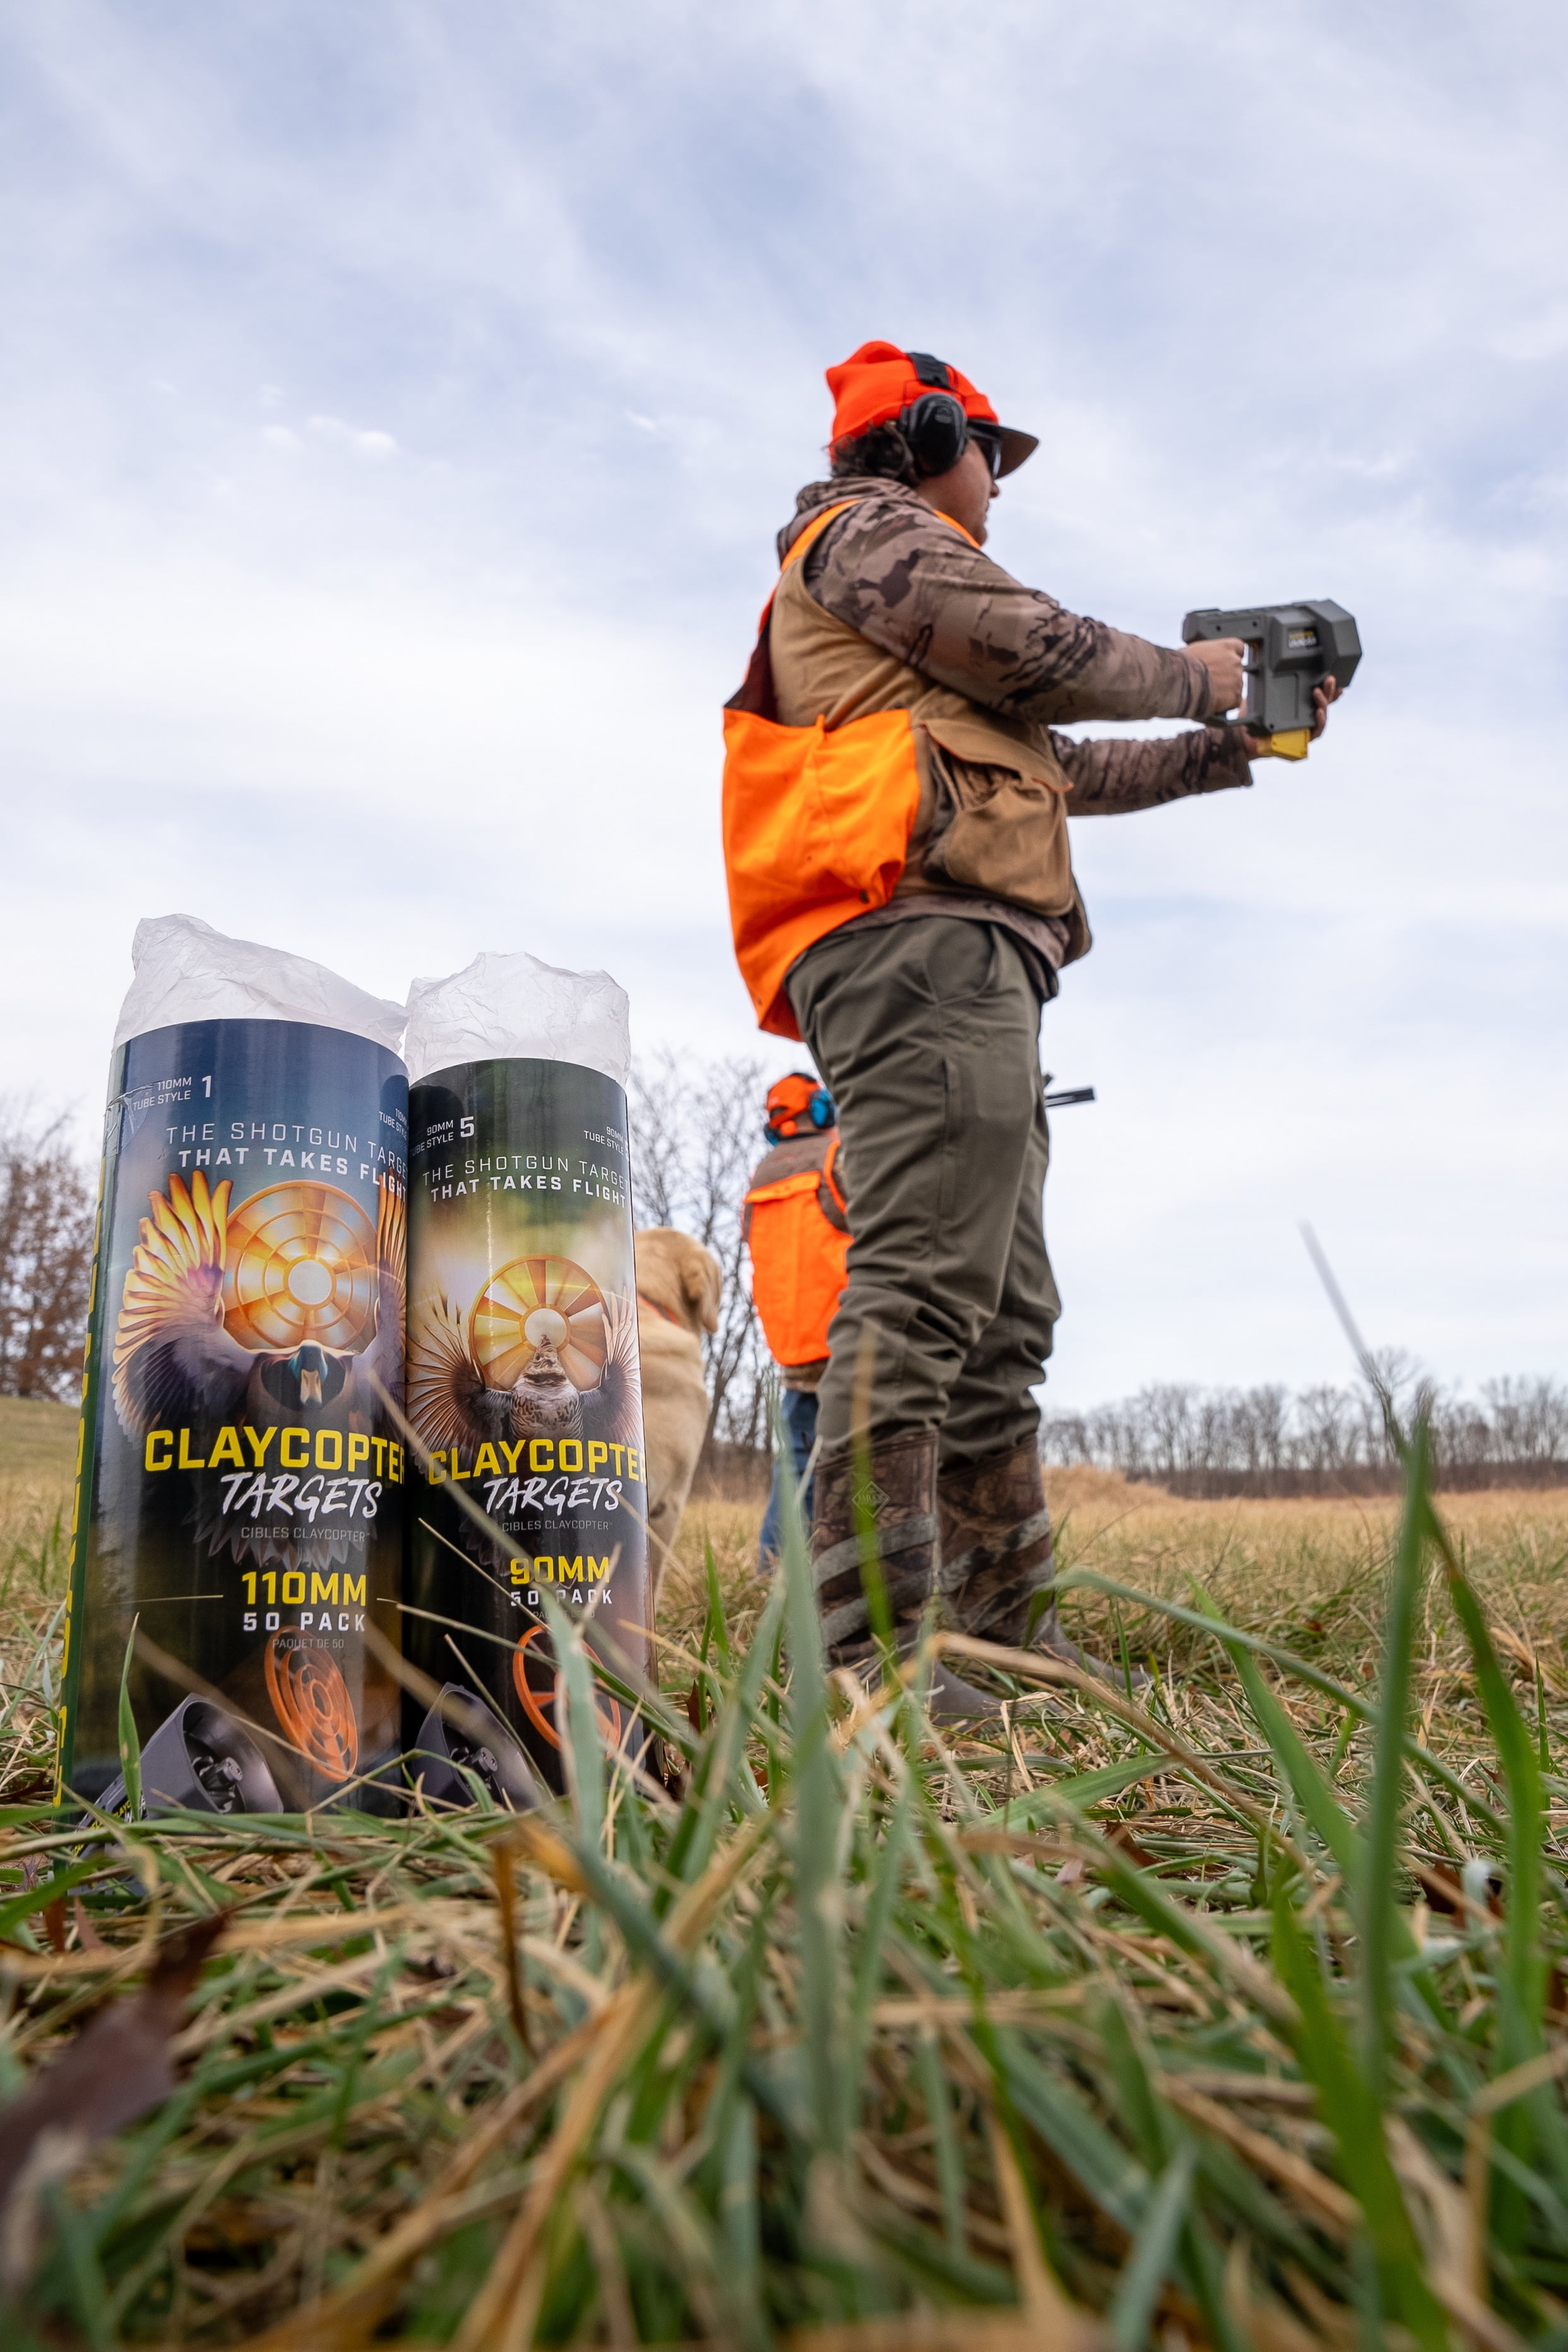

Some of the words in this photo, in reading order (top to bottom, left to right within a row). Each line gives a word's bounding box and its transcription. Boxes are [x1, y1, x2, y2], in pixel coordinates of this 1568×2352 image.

[157, 1076, 192, 1091] 110MM
[133, 1096, 155, 1111] TUBE
[158, 1090, 192, 1104] STYLE
[379, 1112, 395, 1129] TUBE
[427, 1119, 454, 1136] 90MM
[460, 1116, 475, 1137] 5
[427, 1132, 454, 1148] STYLE
[583, 1130, 605, 1145] TUBE
[607, 1138, 624, 1155] STYLE
[607, 1126, 624, 1143] 90MM
[166, 1123, 215, 1144] THE
[230, 1122, 357, 1153] SHOTGUN
[367, 1141, 408, 1180] TARGE
[178, 1147, 249, 1167] THAT
[263, 1148, 348, 1175] TAKES
[359, 1163, 406, 1203] FLIGHT
[422, 1163, 454, 1186] THE
[465, 1155, 569, 1175] SHOTGUN
[579, 1160, 629, 1194] TARGET
[431, 1178, 480, 1203] THAT
[490, 1175, 562, 1191] TAKES
[573, 1178, 626, 1209] FLIGHT
[220, 1471, 383, 1523] TARGETS
[483, 1476, 623, 1516] TARGETS
[241, 1527, 289, 1539] CIBLES
[502, 1520, 542, 1532] CIBLES
[510, 1555, 610, 1585] 90MM
[242, 1571, 367, 1607] 110MM
[511, 1589, 539, 1607] 50
[555, 1589, 612, 1604] PACK
[243, 1612, 280, 1631] 50
[300, 1613, 365, 1632] PACK
[272, 1638, 314, 1649] PAQUET
[317, 1638, 330, 1649] DE
[332, 1638, 344, 1649] 50
